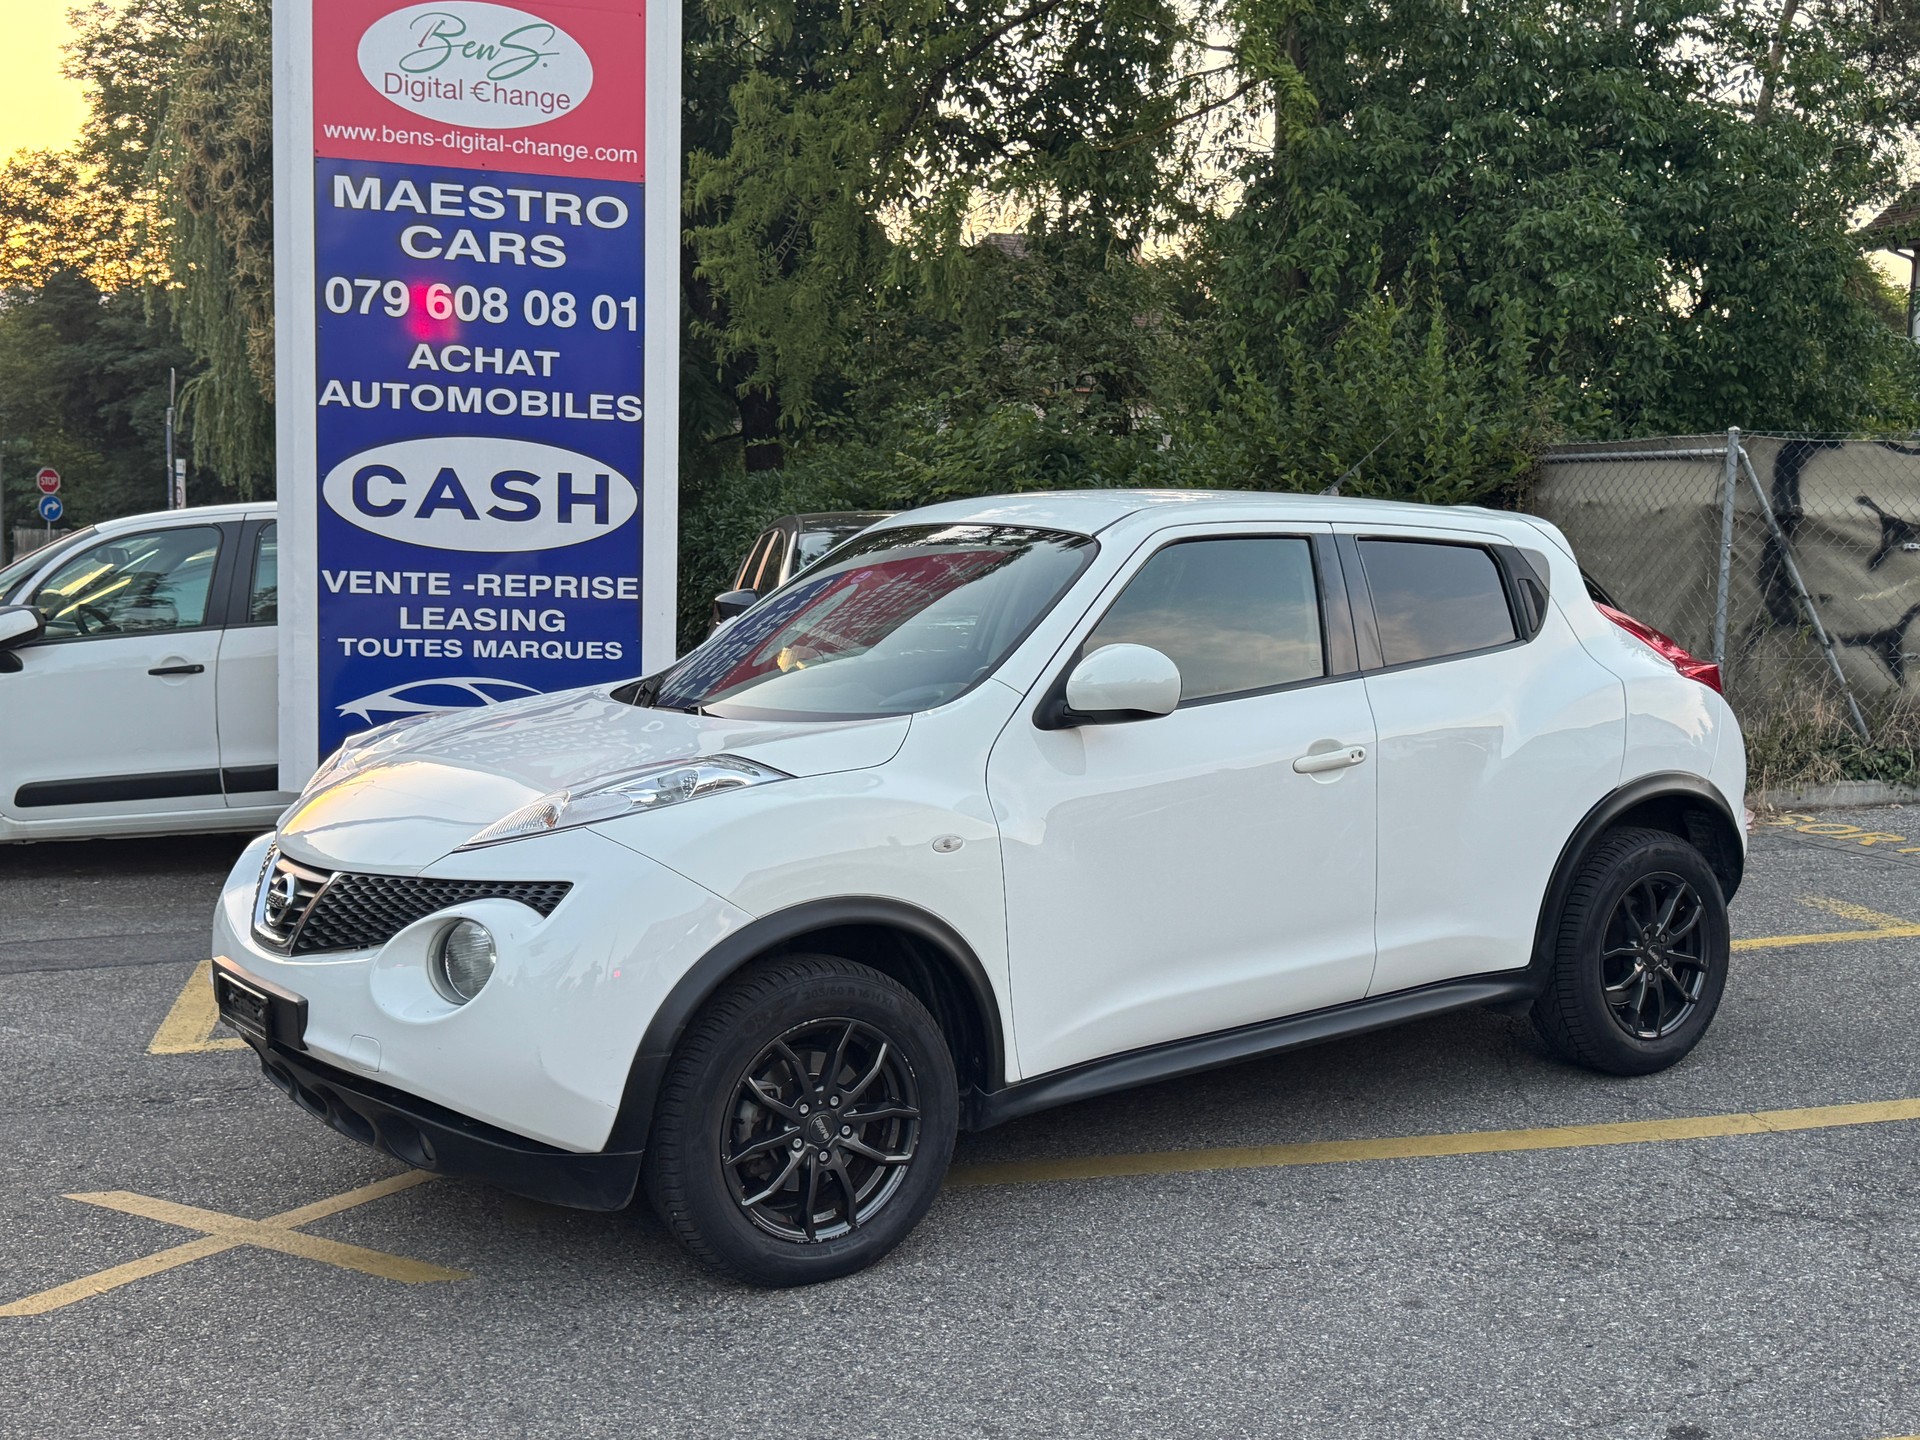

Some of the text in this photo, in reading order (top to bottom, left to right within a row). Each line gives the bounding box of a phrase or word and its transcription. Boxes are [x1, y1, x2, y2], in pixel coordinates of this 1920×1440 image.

[384, 73, 463, 102] Digital
[323, 124, 638, 163] www.bens-digital-change.com
[333, 174, 629, 229] MAESTRO
[400, 225, 567, 268] CARS
[324, 276, 638, 331] 079 608 08 01
[408, 343, 560, 377] ACHAT
[318, 379, 643, 422] AUTOMOBILES
[40, 476, 57, 486] STOP
[351, 464, 610, 525] CASH
[321, 569, 451, 596] VENTE
[400, 606, 566, 633] LEASING
[338, 637, 623, 661] TOUTES MARQUES
